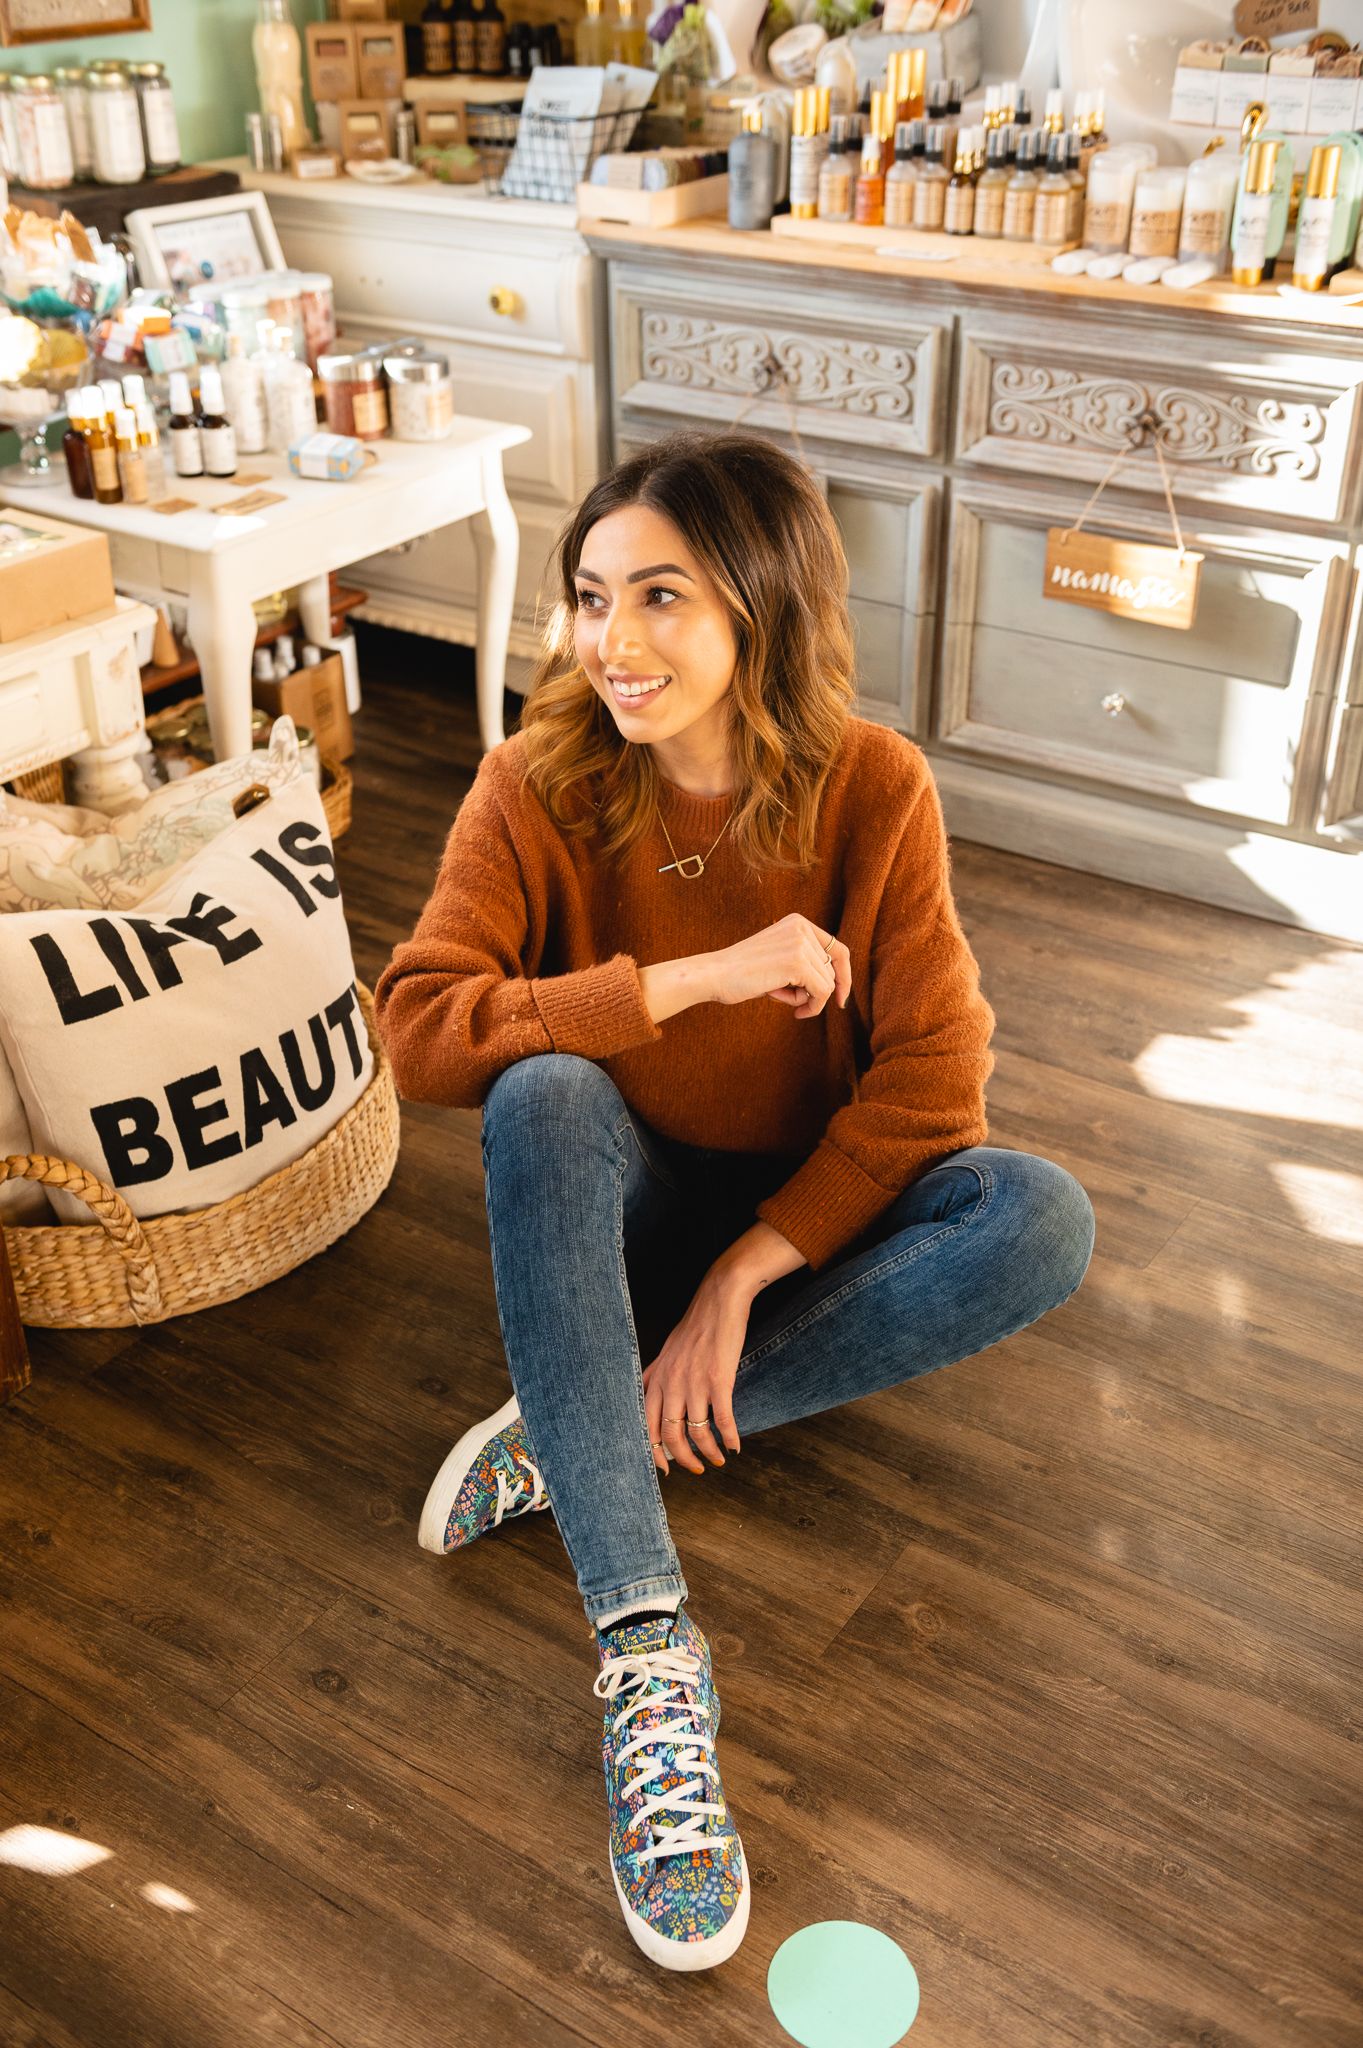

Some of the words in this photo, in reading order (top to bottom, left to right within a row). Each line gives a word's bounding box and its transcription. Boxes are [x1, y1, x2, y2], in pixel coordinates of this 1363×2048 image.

[30, 893, 264, 1025] LIFE
[250, 821, 341, 917] IS
[90, 980, 363, 1188] BEAUT
